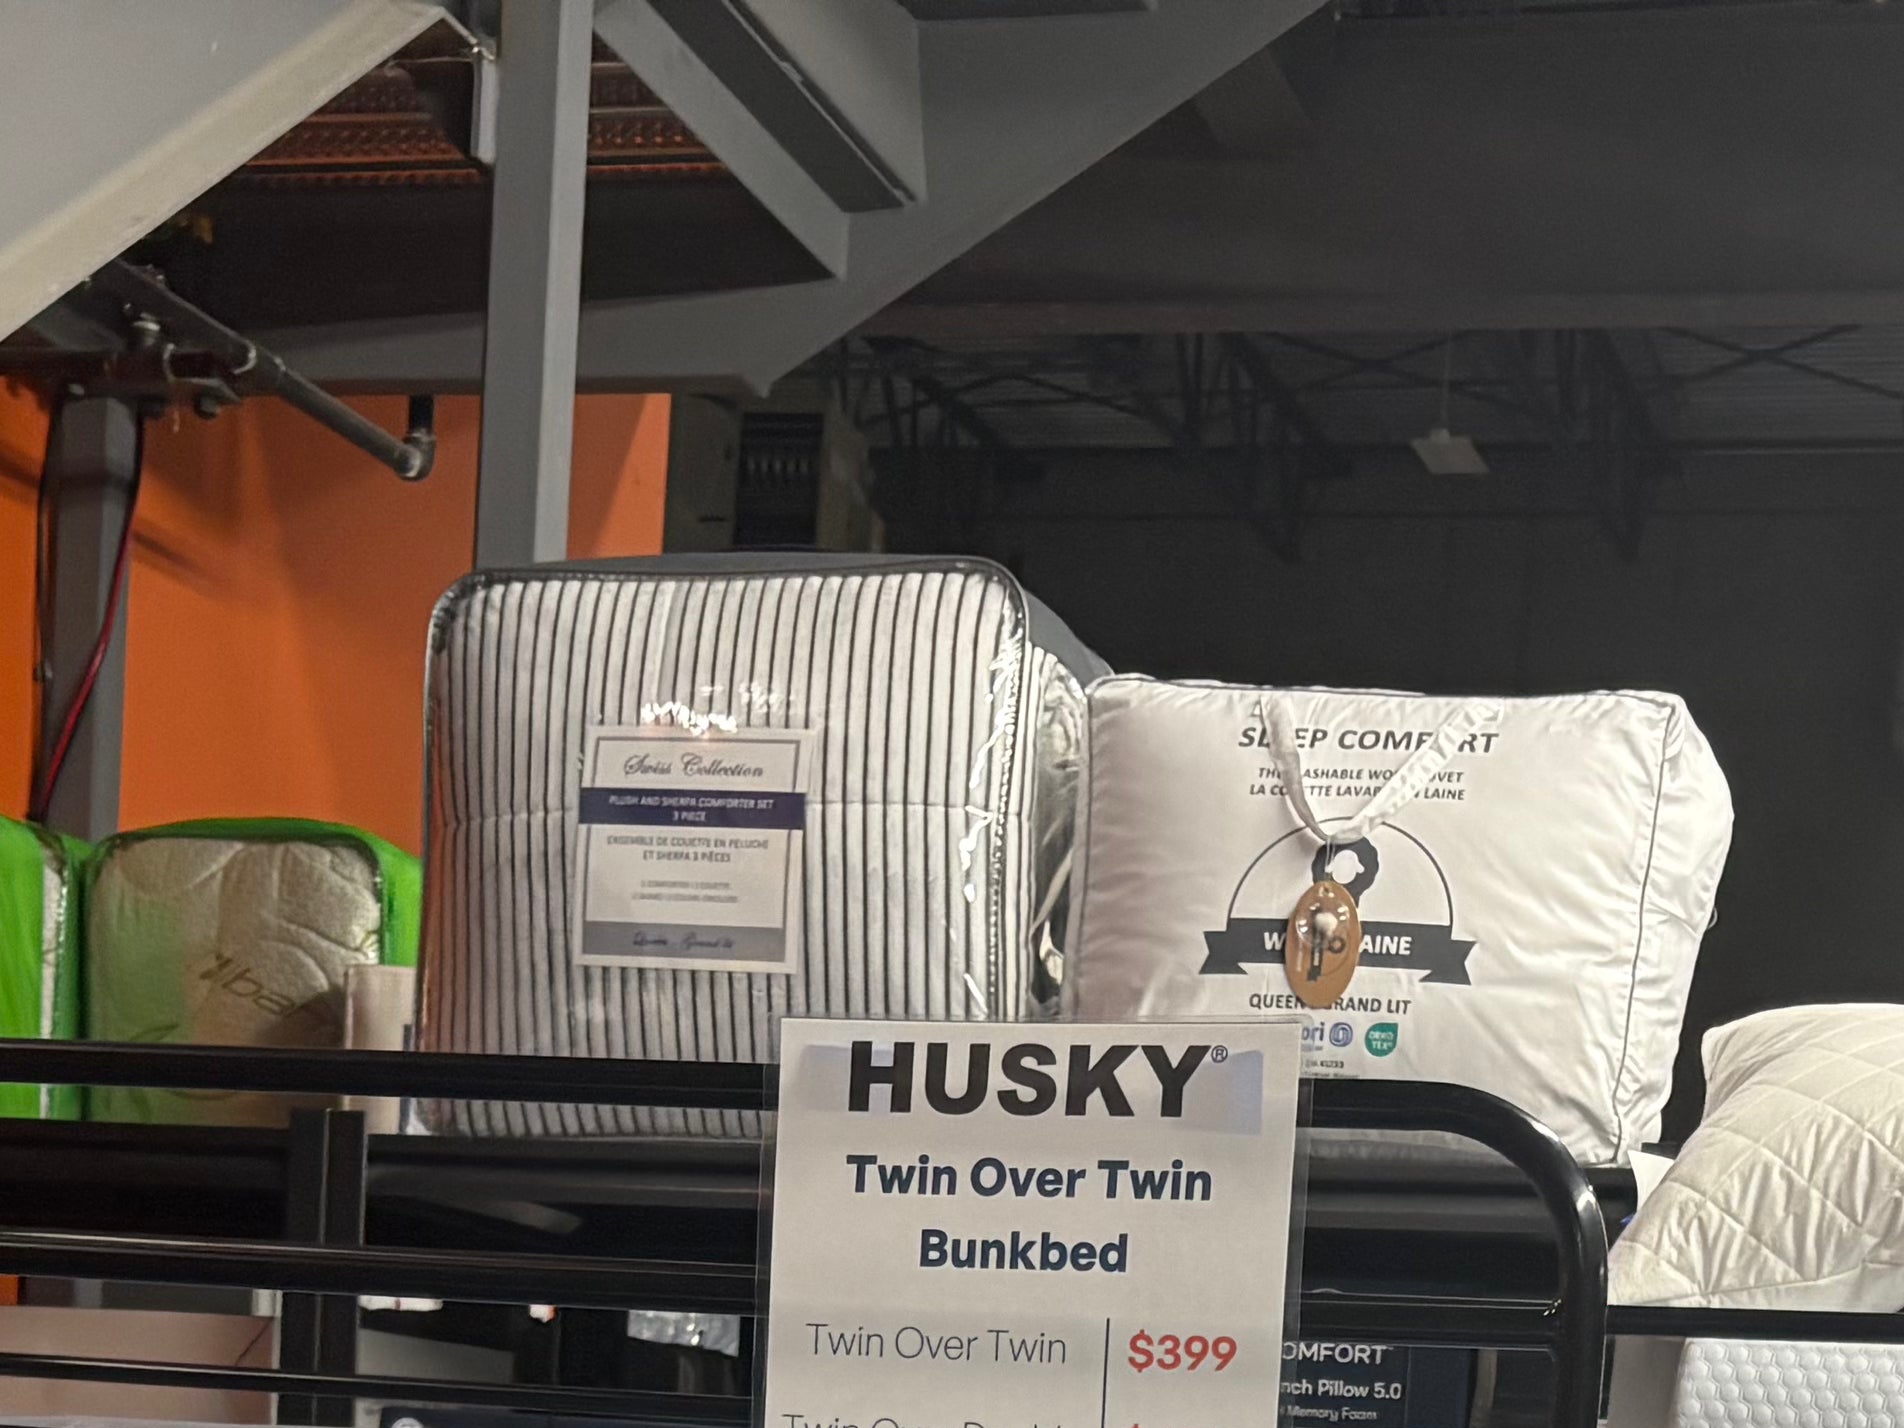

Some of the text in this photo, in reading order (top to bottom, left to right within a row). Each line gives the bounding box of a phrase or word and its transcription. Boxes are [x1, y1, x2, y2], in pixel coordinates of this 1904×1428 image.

[1238, 726, 1499, 753] SLEP COMFRT
[624, 752, 764, 777] Swiss Collection
[1303, 768, 1364, 780] ASHABLE
[640, 795, 660, 806] AND
[698, 797, 755, 809] COMFORTER
[1249, 784, 1267, 795] LA
[1424, 787, 1465, 800] LAINE
[656, 836, 668, 846] DE
[1358, 934, 1413, 956] AINE
[1330, 996, 1382, 1013] RAND
[1386, 999, 1412, 1015] LIT
[846, 1153, 1213, 1201] Twin Over Twin
[919, 1228, 1128, 1273] Bunkbed
[806, 1322, 1067, 1364] Twin Over Twin
[1127, 1328, 1238, 1374] $399
[1317, 1379, 1370, 1397] Pillow
[1373, 1382, 1402, 1400] 5.0
[1287, 1404, 1378, 1421] Memory Foam
